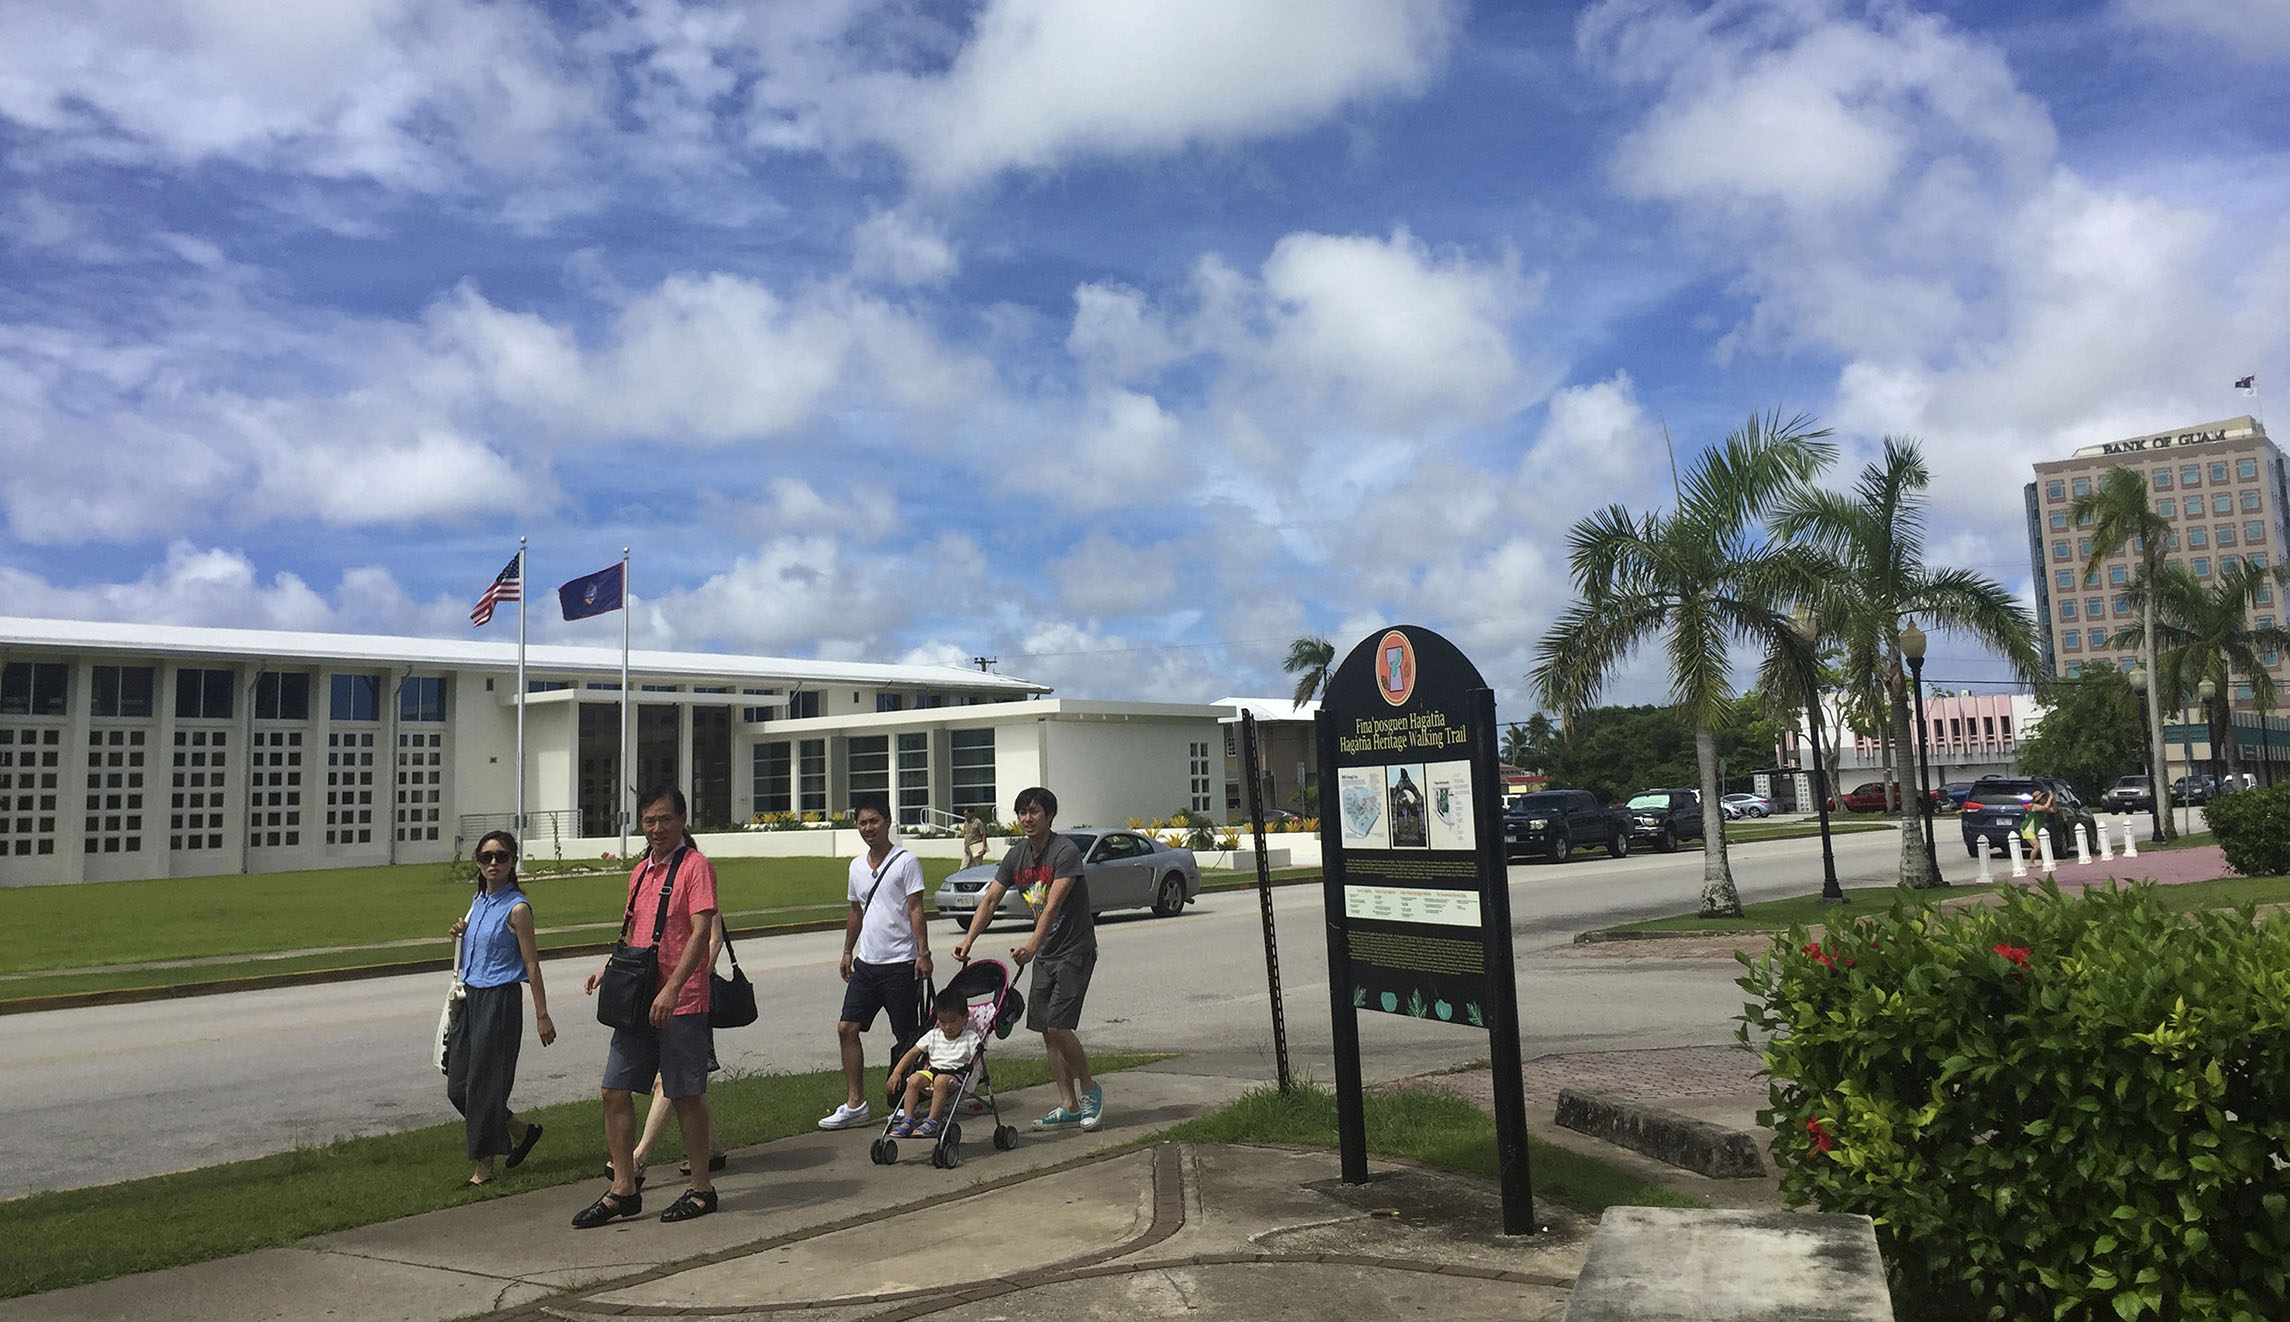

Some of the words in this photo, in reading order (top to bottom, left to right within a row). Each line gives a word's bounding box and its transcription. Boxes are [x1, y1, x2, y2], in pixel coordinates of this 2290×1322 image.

[2102, 440, 2147, 455] BANK
[2152, 437, 2172, 449] OF
[2178, 429, 2227, 446] GUAM
[1373, 733, 1408, 752] Heritage
[1408, 728, 1444, 749] Walking
[1444, 724, 1467, 744] Trail
